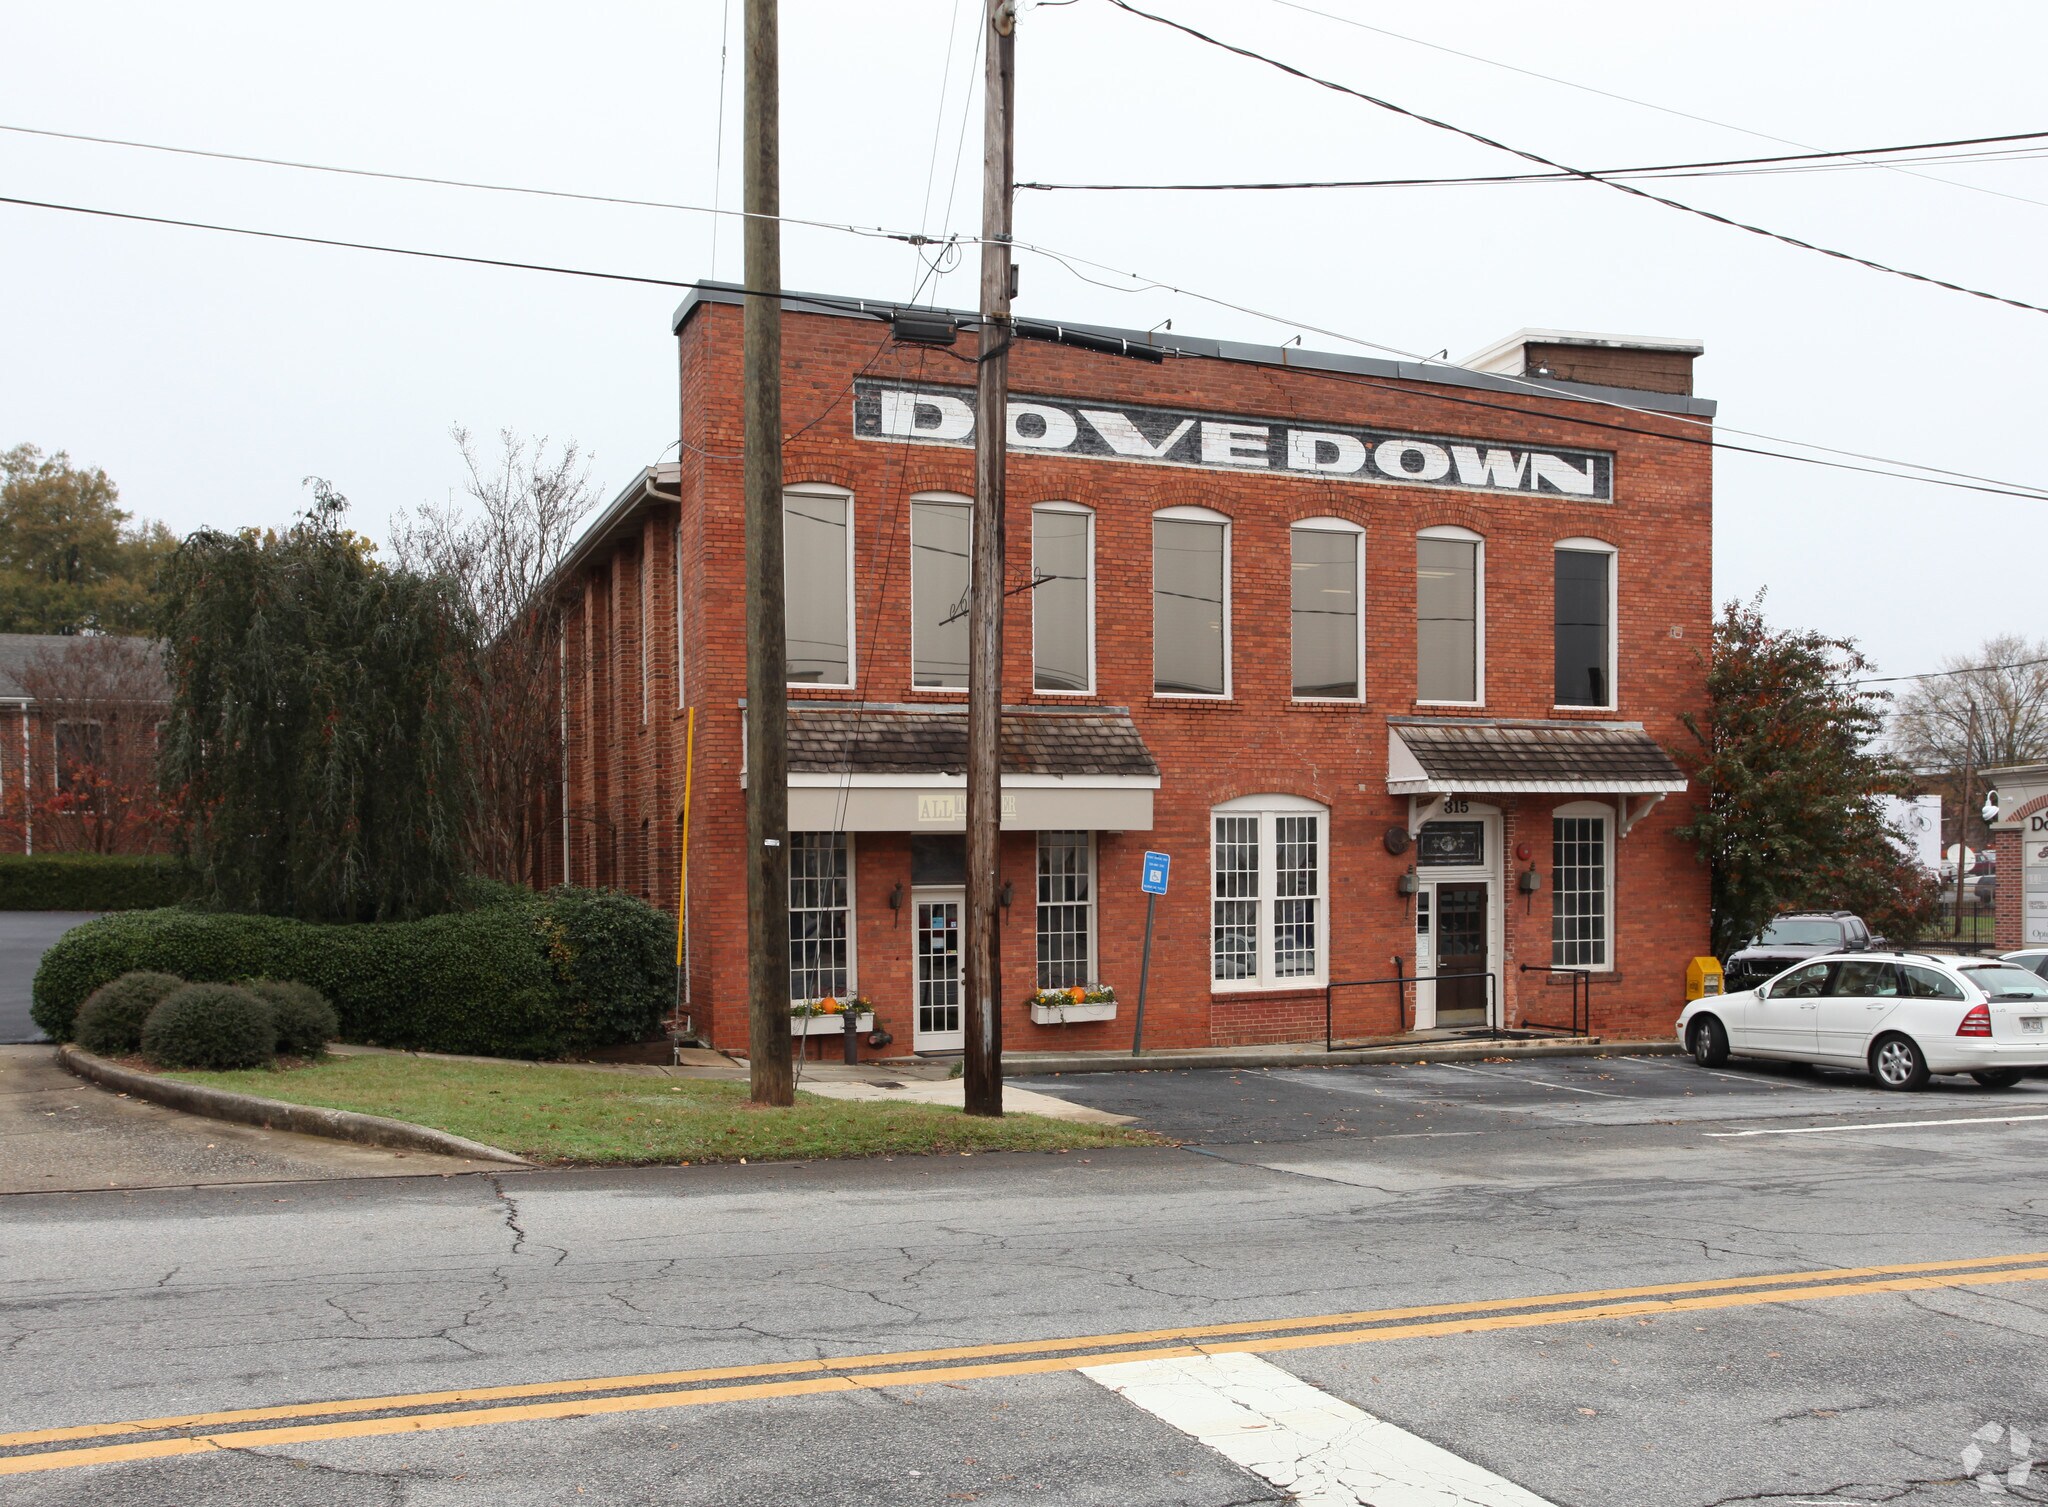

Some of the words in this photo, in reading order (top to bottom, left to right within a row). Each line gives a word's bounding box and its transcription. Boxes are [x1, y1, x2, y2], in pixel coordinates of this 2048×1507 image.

[881, 390, 1594, 495] DOVEDOWN
[920, 800, 953, 819] ALL
[1444, 801, 1469, 814] 315
